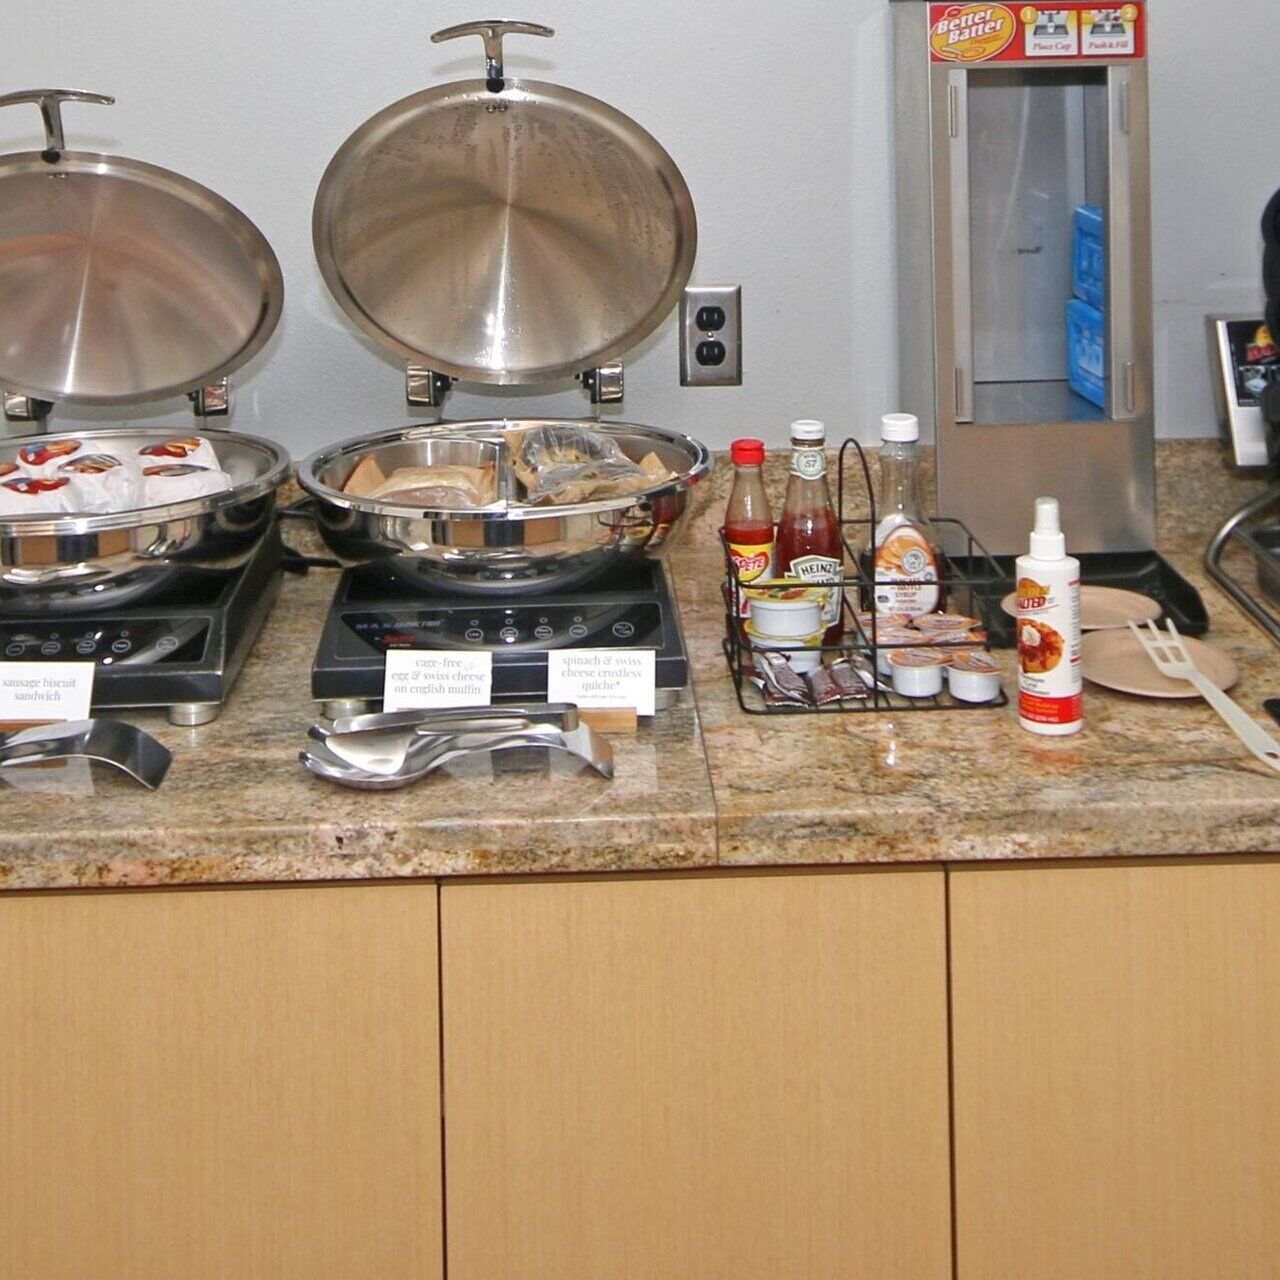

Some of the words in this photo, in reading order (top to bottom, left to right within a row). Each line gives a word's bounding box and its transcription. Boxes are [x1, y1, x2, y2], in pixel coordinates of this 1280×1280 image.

[937, 8, 994, 34] Better
[948, 19, 1004, 44] Batter
[800, 563, 833, 576] HEINZ
[415, 657, 463, 669] cage-free
[562, 655, 600, 668] spinach
[615, 655, 642, 666] swiss
[391, 672, 410, 682] egg
[423, 671, 450, 681] swiss
[451, 671, 486, 682] cheese
[561, 666, 596, 678] cheese
[597, 667, 643, 678] crustless
[2, 679, 41, 689] sausage
[42, 677, 77, 688] biscuit
[394, 686, 408, 694] on
[409, 683, 446, 696] english
[448, 684, 481, 695] muffin
[13, 690, 62, 702] sandwich
